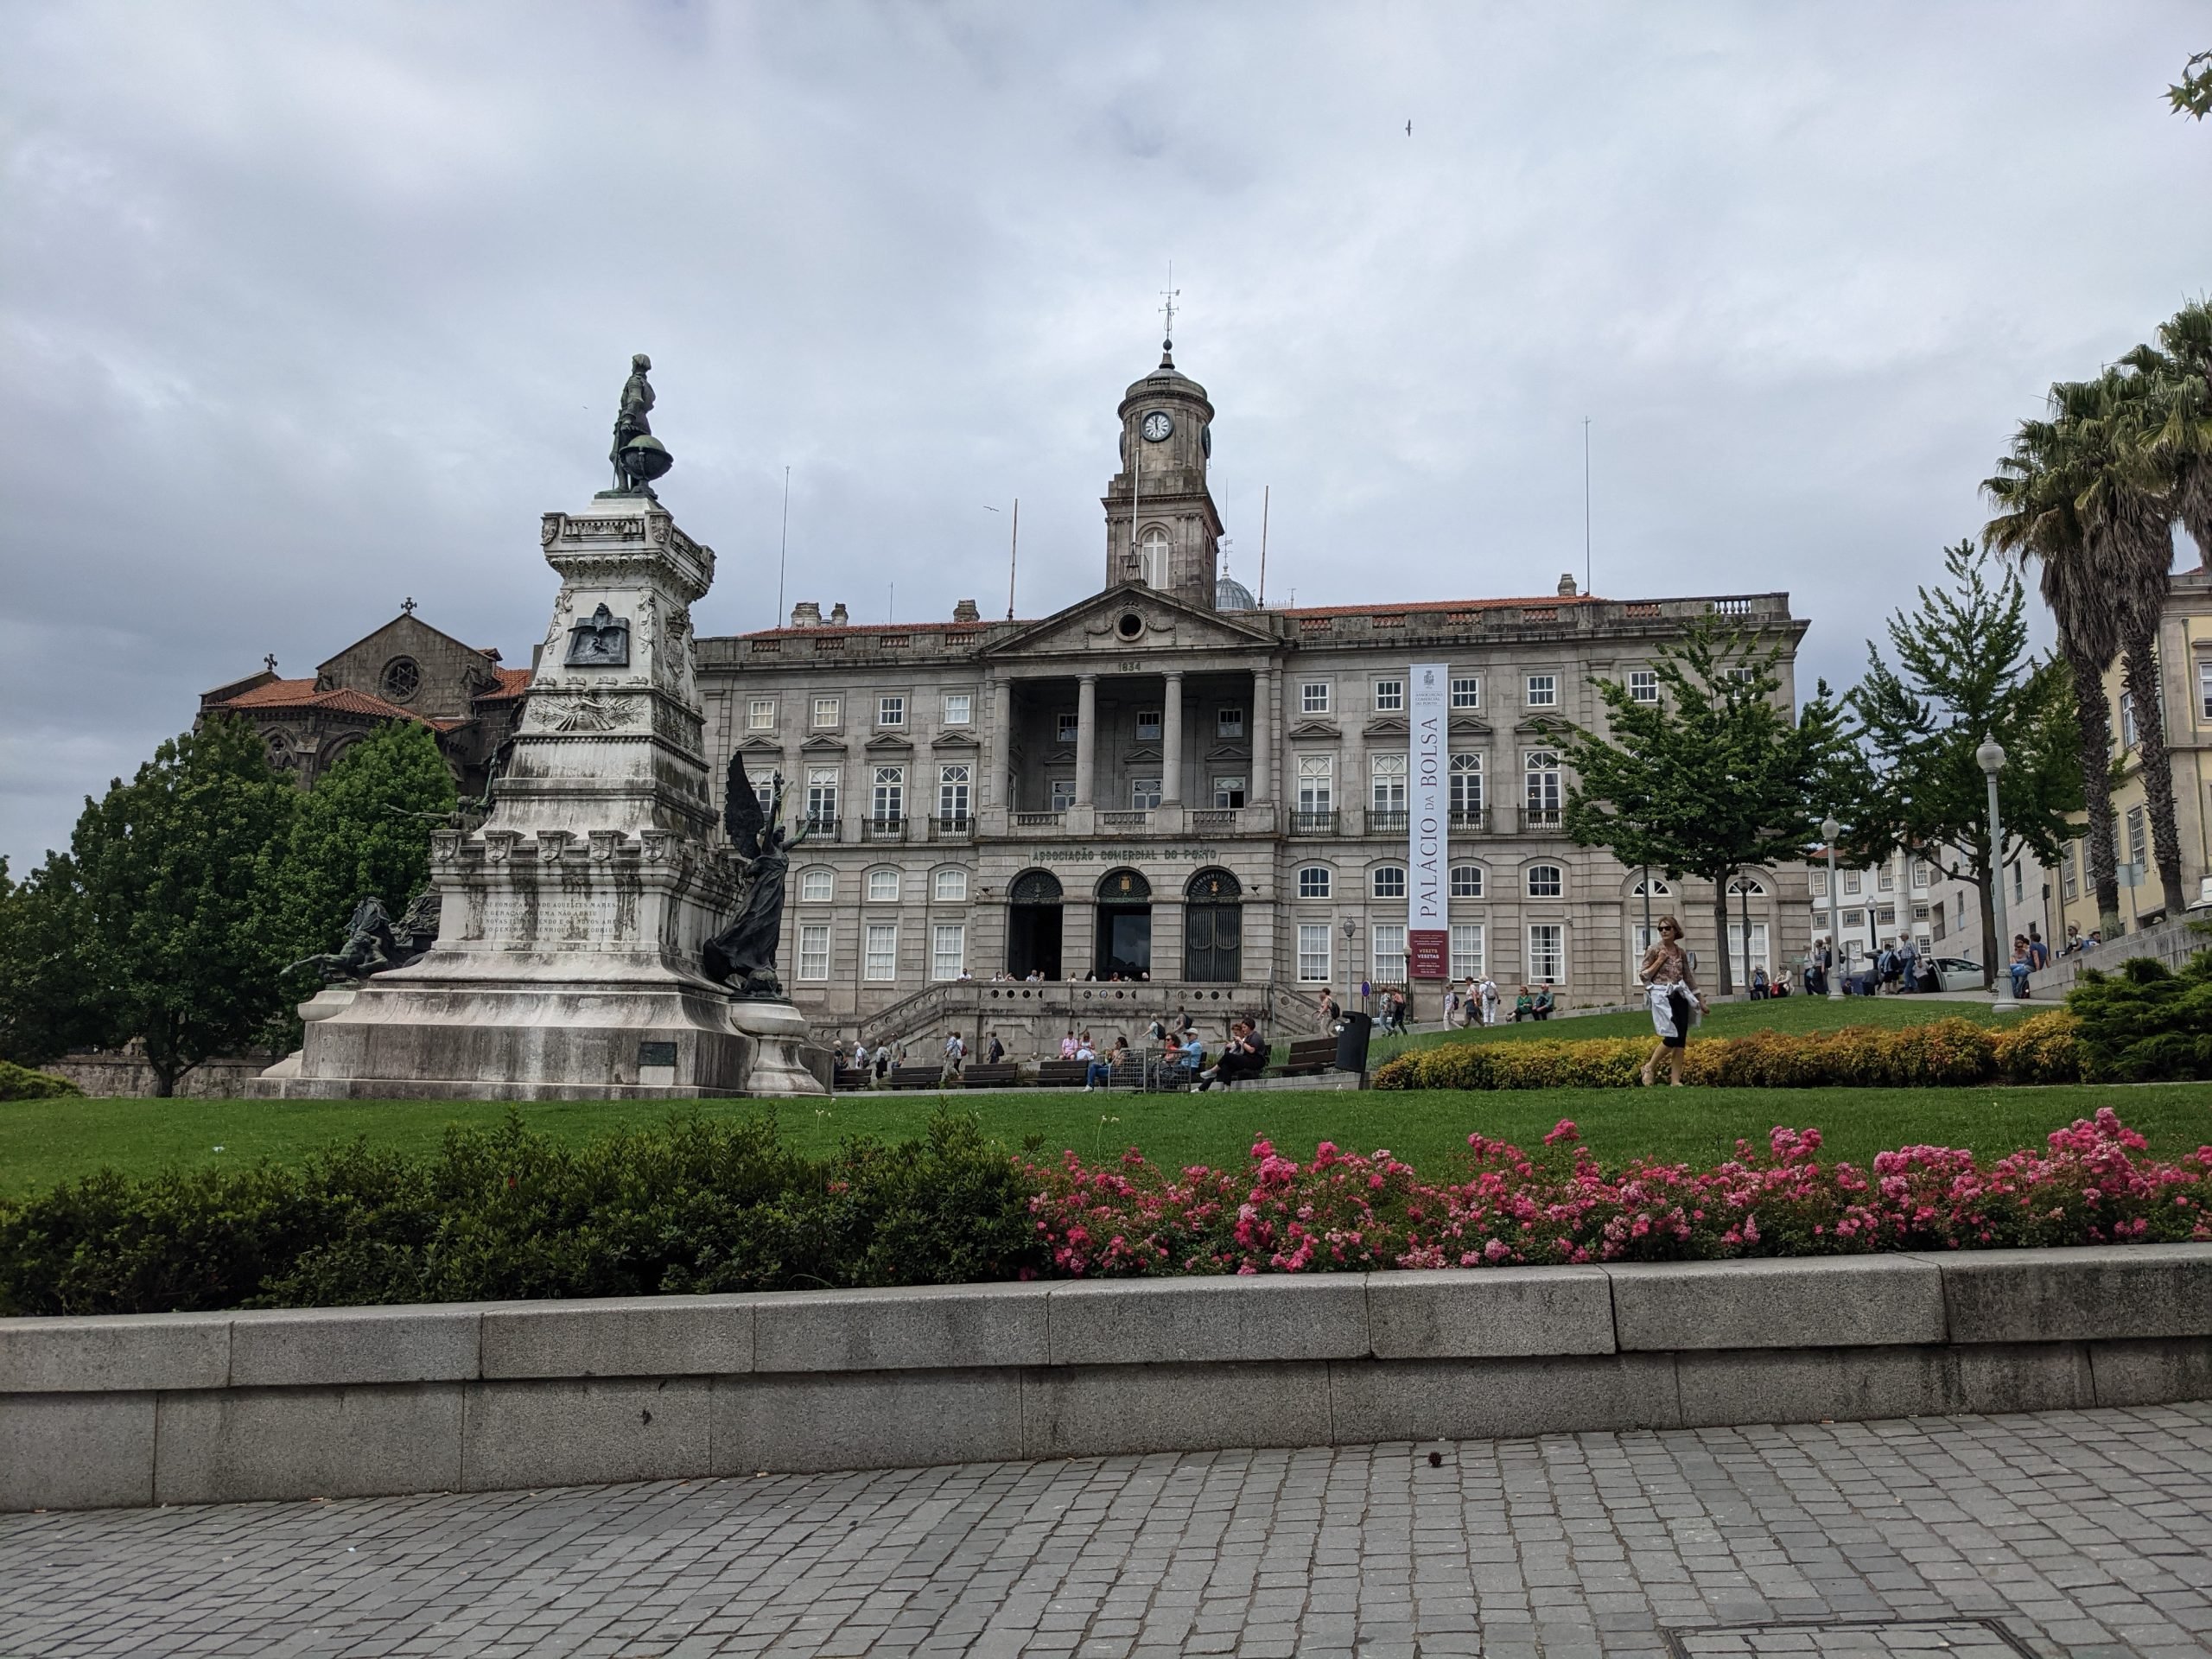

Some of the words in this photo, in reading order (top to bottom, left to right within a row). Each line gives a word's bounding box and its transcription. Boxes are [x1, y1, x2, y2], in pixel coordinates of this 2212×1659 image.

[1119, 662, 1141, 672] 1834
[1420, 716, 1438, 787] BOLSA
[1424, 795, 1434, 810] DA
[1033, 847, 1095, 862] ASSOCIAÇÃO
[1100, 849, 1158, 861] COMERCIAL
[1164, 849, 1178, 860] DO
[1184, 849, 1217, 860] PORTO
[1416, 817, 1438, 918] PALÁCIO
